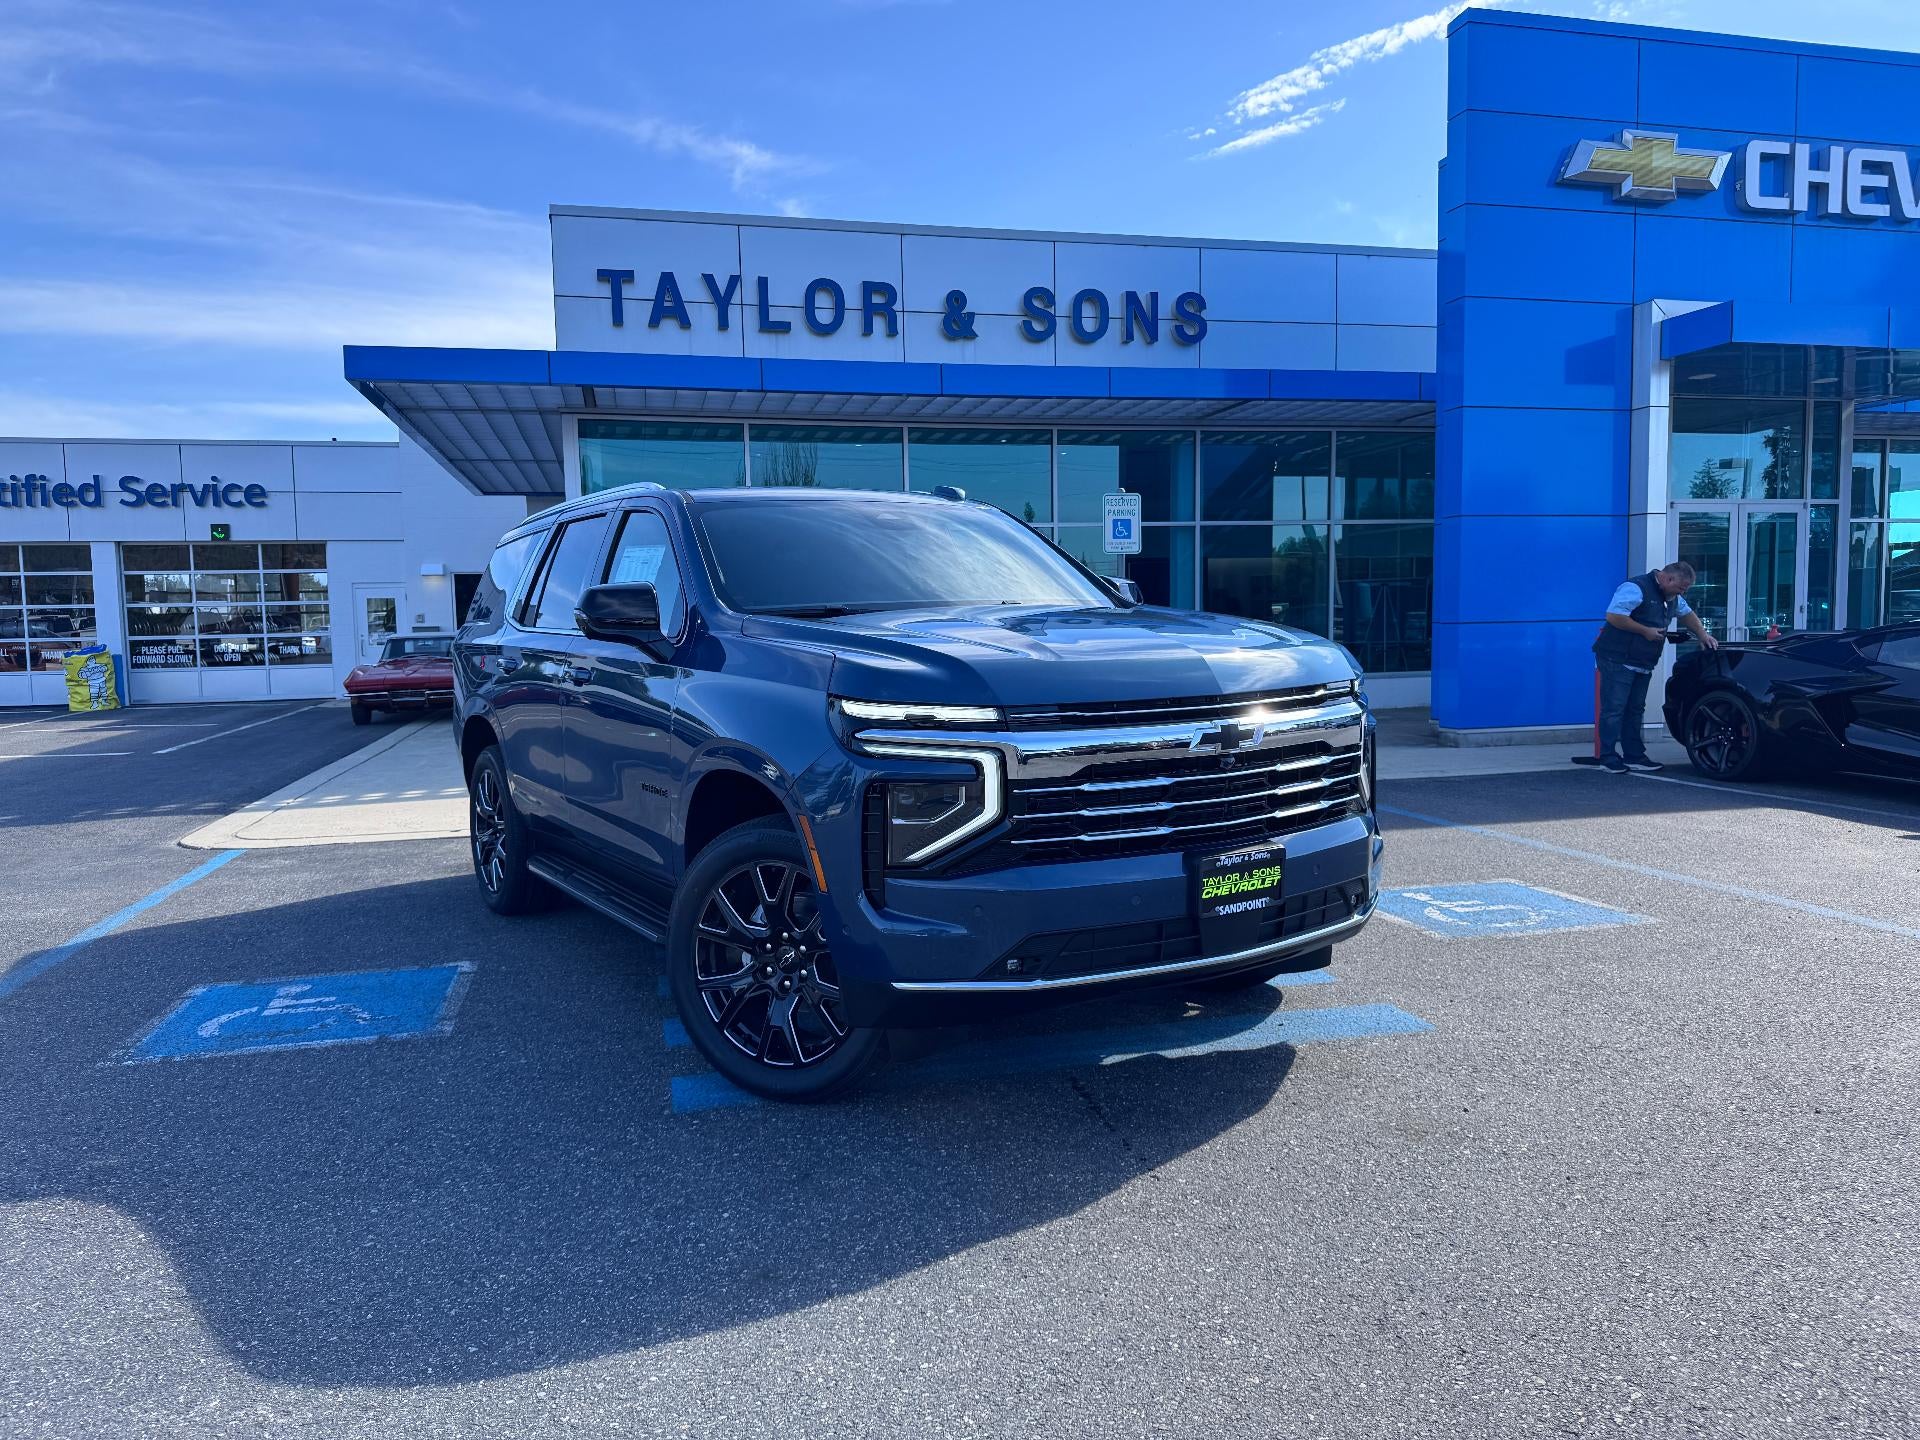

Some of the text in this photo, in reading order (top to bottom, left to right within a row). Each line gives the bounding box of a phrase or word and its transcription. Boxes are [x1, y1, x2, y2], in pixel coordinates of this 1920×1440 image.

[1742, 140, 1920, 218] CHEV
[596, 268, 1209, 345] TAYLOR & SONS
[118, 475, 268, 508] Service
[141, 645, 184, 654] PLEASE PULL
[223, 653, 241, 661] OPEN
[278, 645, 300, 655] THANK
[133, 655, 193, 663] FORWARD SLOWLY
[1220, 855, 1244, 866] Taylor
[1251, 852, 1267, 860] Sons
[1203, 866, 1281, 887] TAYLOR & SONS
[1202, 876, 1281, 898] CHEVROLET
[1220, 899, 1266, 916] SANDPOINT
